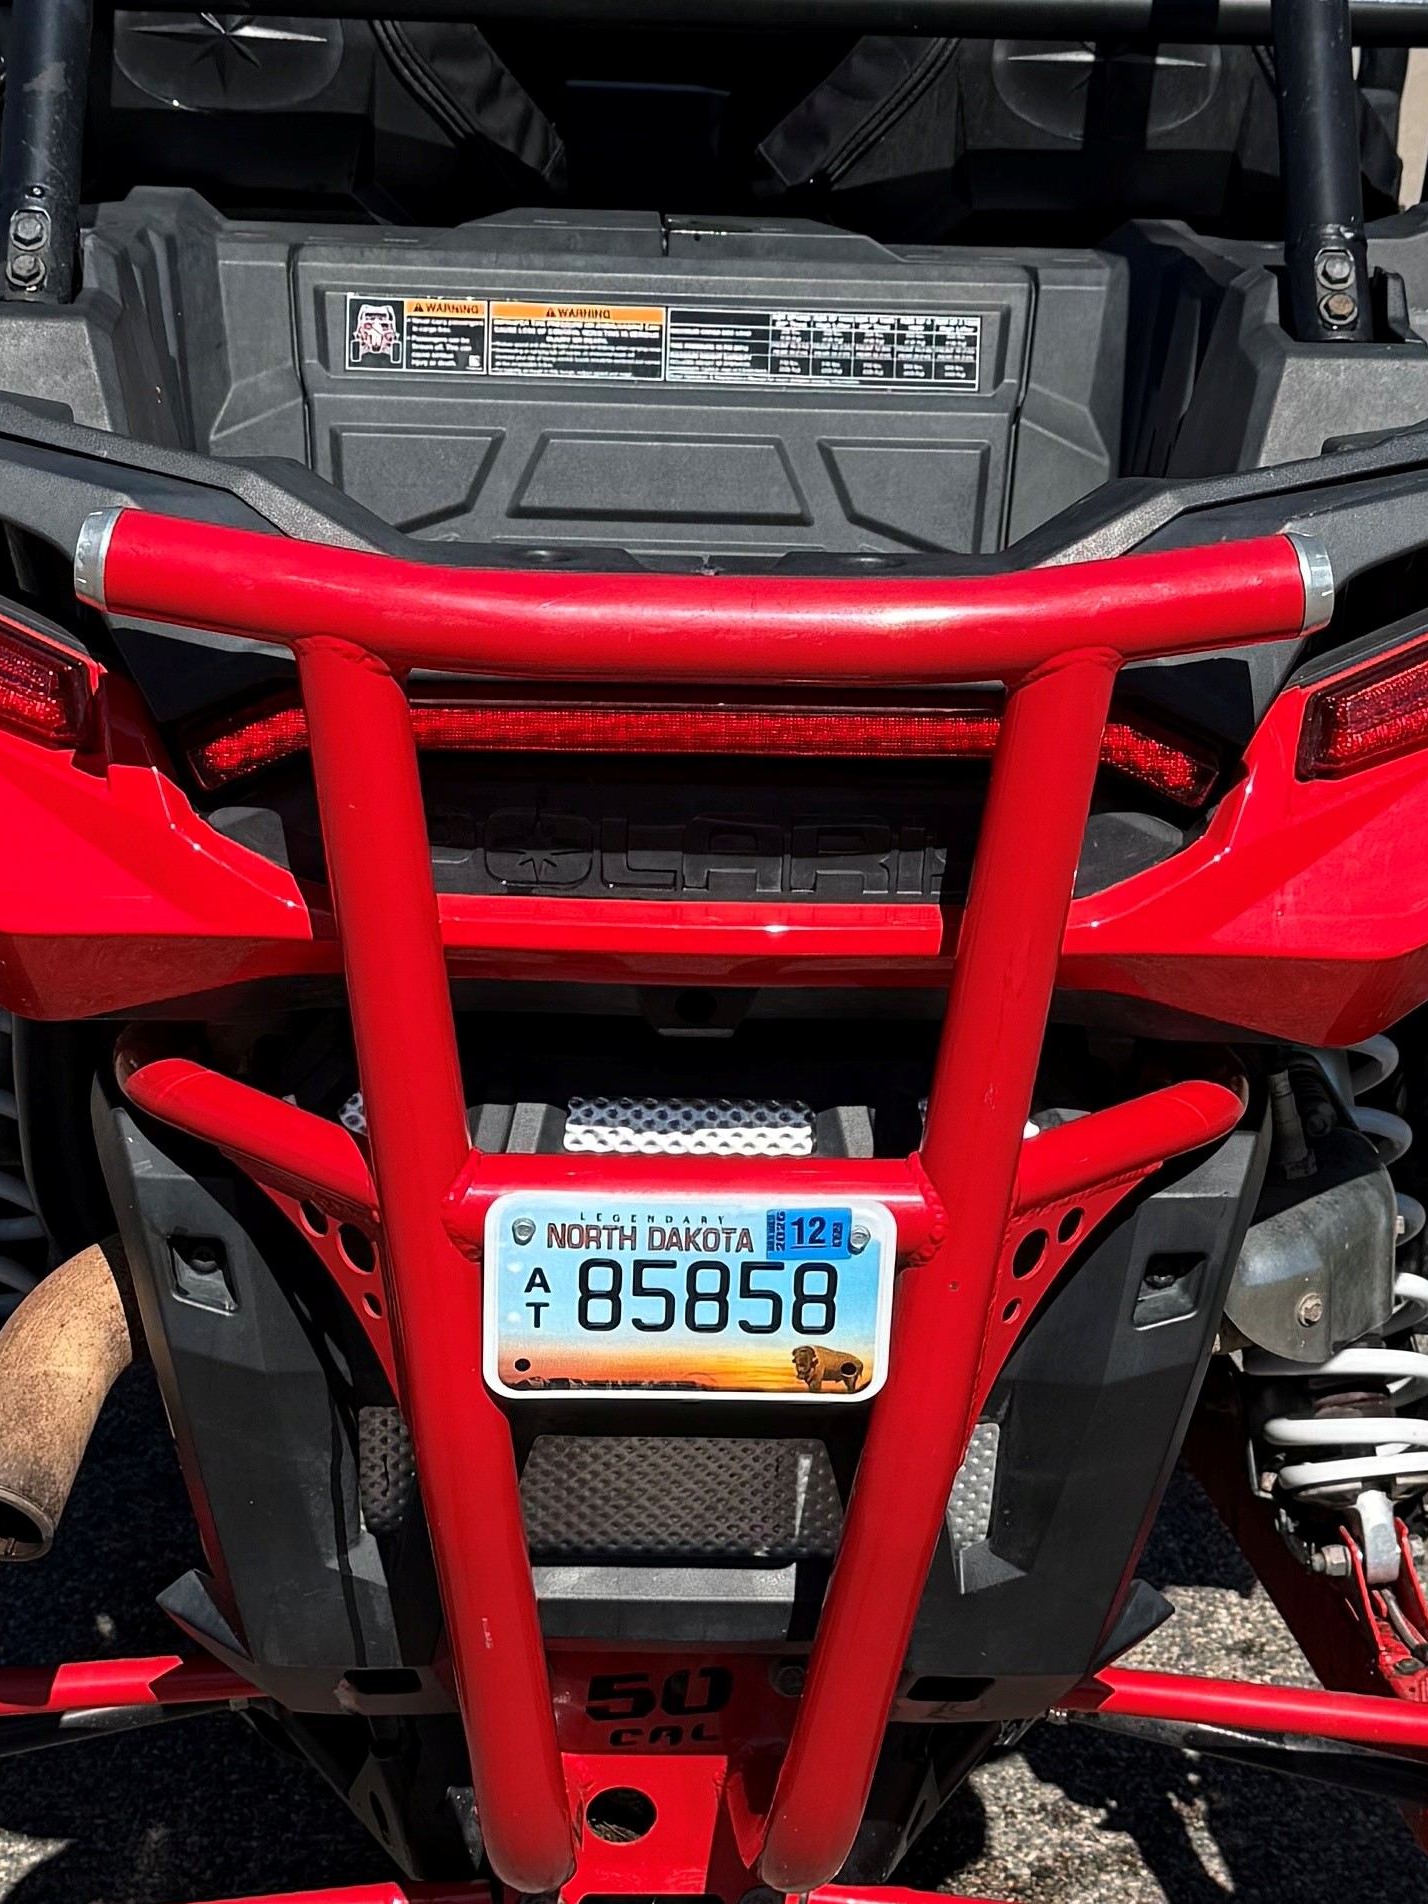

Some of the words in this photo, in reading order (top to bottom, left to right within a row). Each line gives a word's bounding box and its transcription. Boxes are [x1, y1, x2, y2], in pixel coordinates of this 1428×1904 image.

[425, 302, 479, 314] WARNING
[557, 307, 611, 319] WARNING
[580, 1211, 726, 1225] LEGENDARY
[790, 1216, 826, 1245] 12
[546, 1223, 637, 1252] NORTH
[647, 1226, 755, 1254] DAKOTA
[577, 1258, 839, 1335] 85858
[585, 1666, 734, 1721] 50
[609, 1724, 720, 1746] CAL
